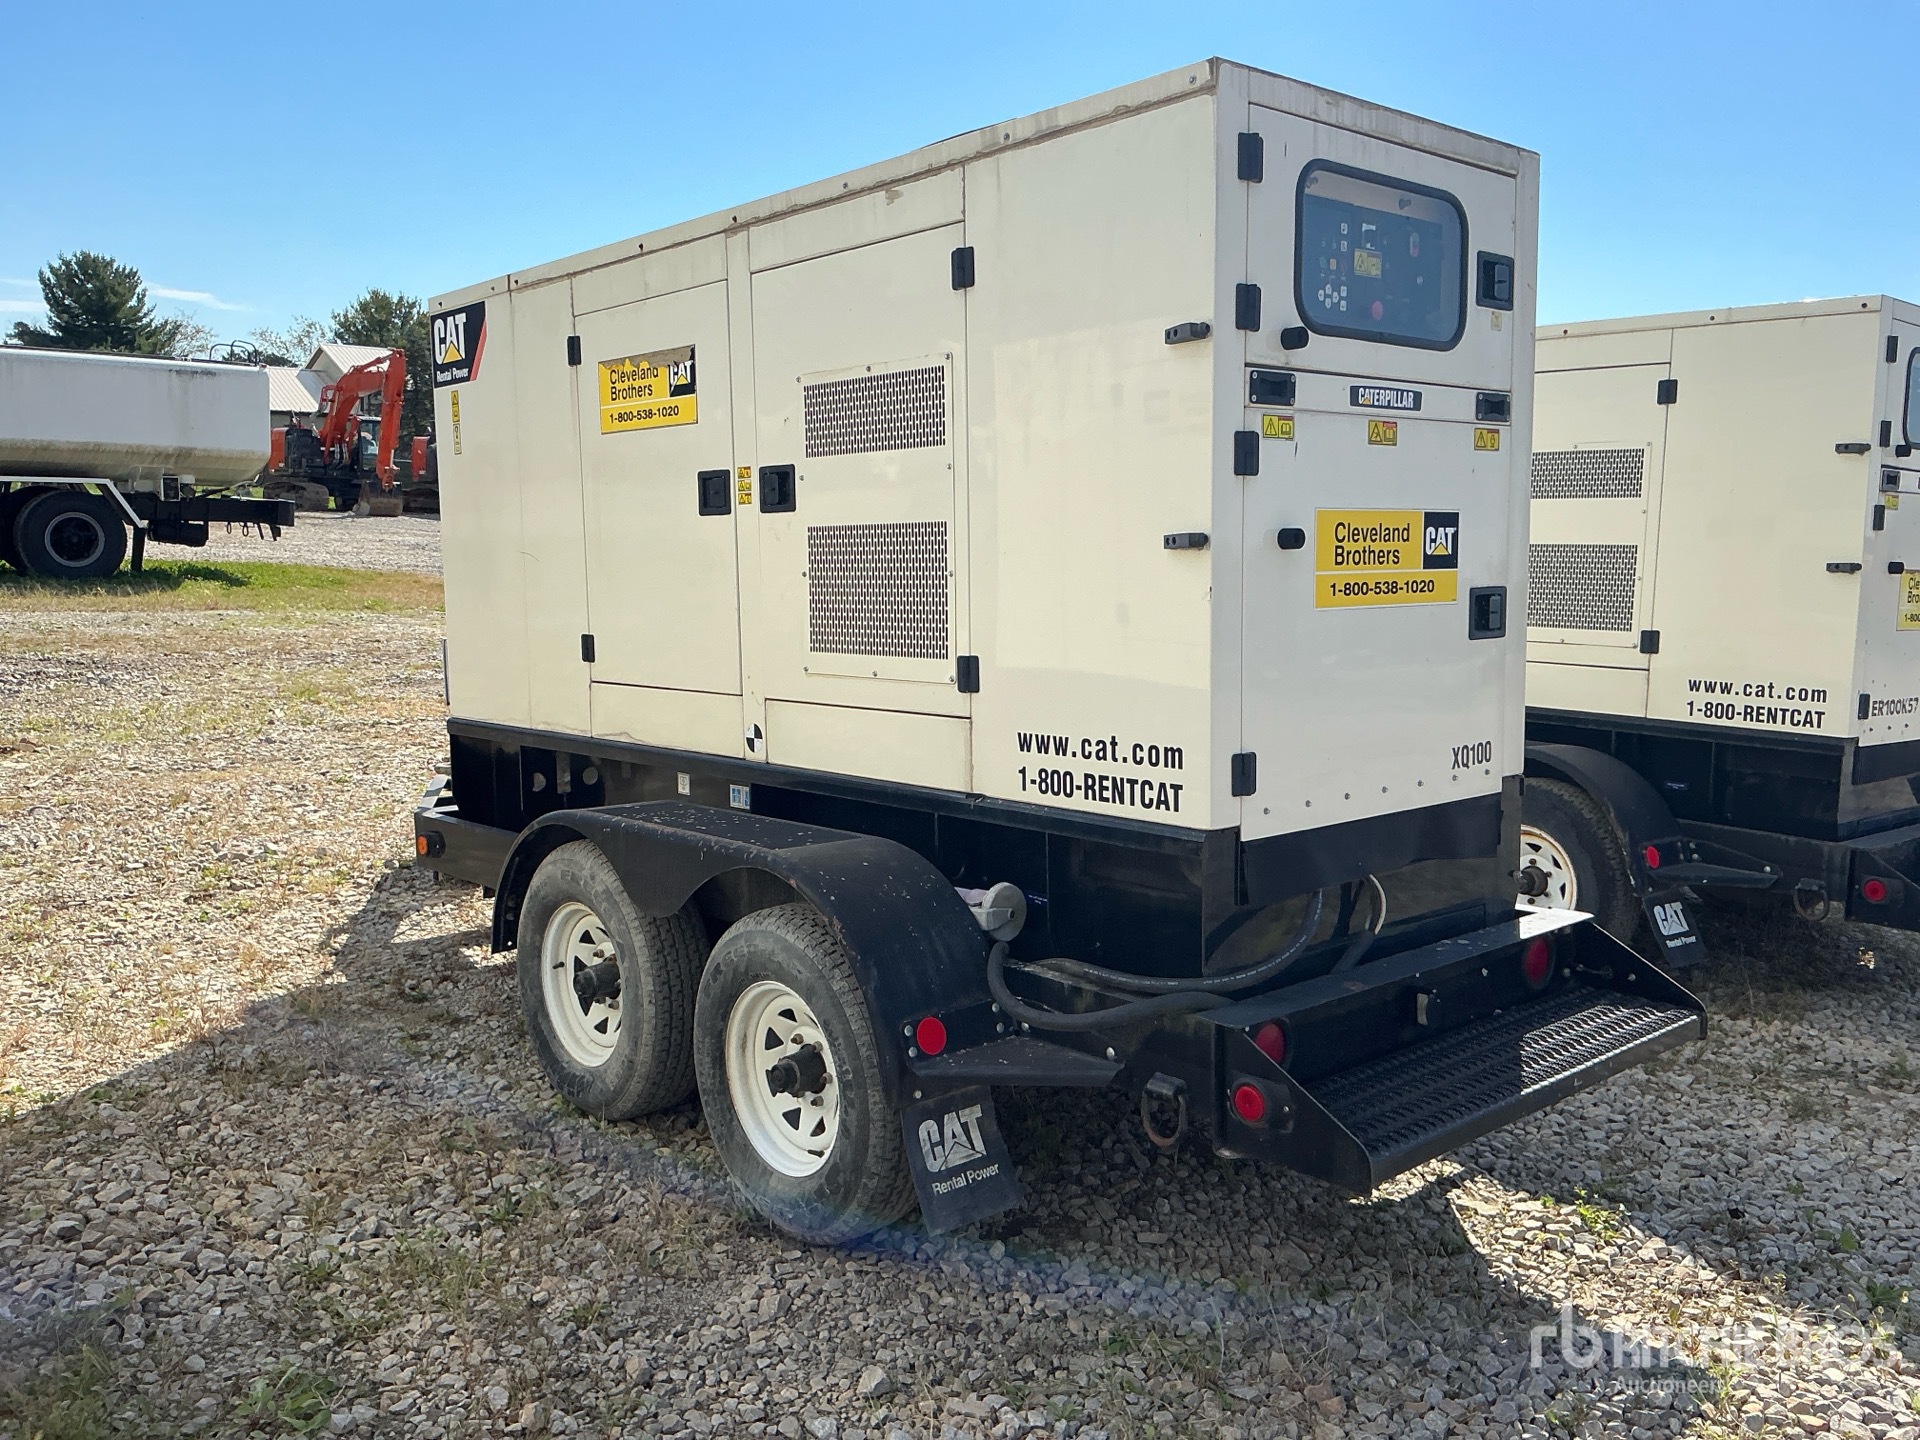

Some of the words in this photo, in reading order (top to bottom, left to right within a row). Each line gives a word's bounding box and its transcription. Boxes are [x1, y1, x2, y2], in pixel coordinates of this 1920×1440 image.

[433, 312, 466, 365] CAT
[436, 366, 452, 384] Rental
[453, 366, 470, 380] Power
[610, 383, 653, 402] Brothers
[1358, 387, 1414, 409] CATERPILLAR
[609, 404, 679, 424] 1-800-538-1020
[1334, 521, 1411, 544] Cleveland
[1425, 525, 1457, 556] CAT
[1334, 544, 1400, 566] Brothers
[1330, 579, 1435, 597] 1-800-538-1020
[1688, 679, 1828, 703] www.cat.com
[1686, 700, 1826, 729] 1-800-RENTCAT
[1017, 731, 1184, 770] www.cat.com
[1451, 740, 1492, 770] XQ100
[1018, 766, 1184, 813] 1-800-RENTCAT
[1653, 901, 1690, 936] CAT
[918, 1103, 987, 1173] CAT
[931, 1173, 967, 1196] Rental
[966, 1163, 999, 1184] Power
